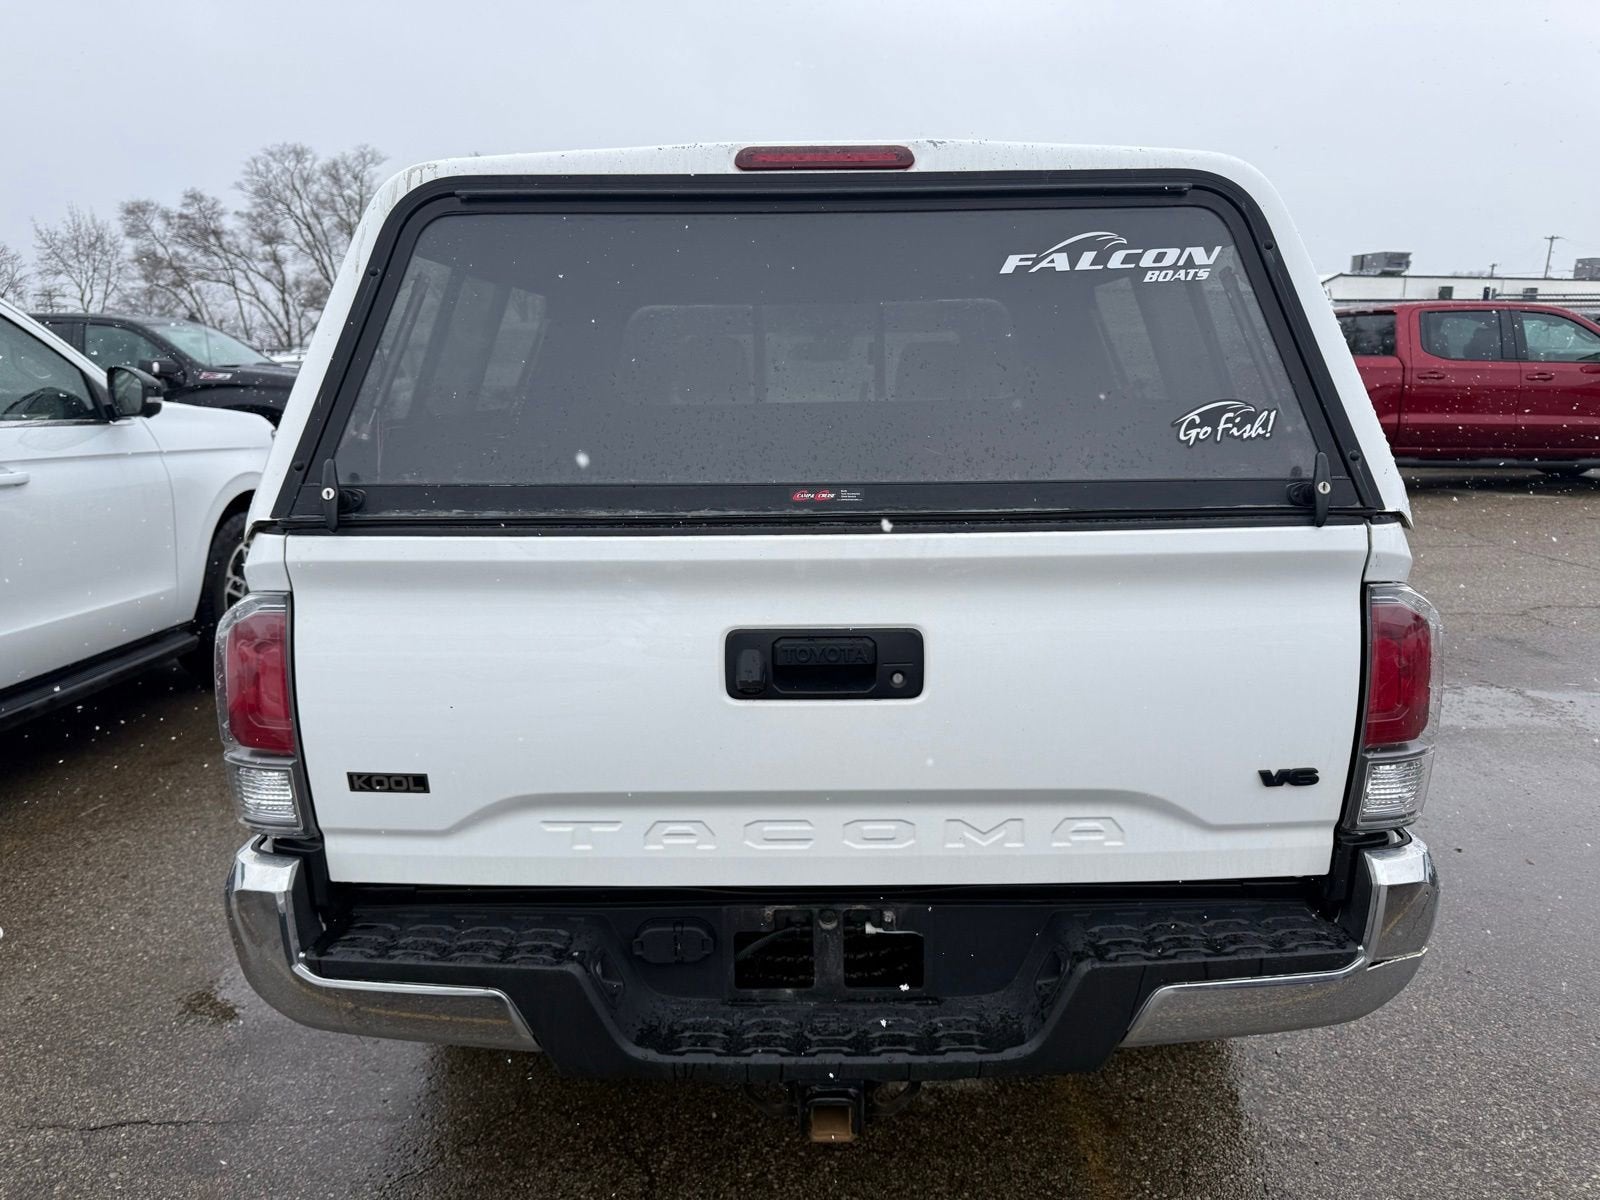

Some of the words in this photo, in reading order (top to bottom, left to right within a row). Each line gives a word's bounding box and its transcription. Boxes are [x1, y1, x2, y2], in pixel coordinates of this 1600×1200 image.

[999, 246, 1222, 274] FALCON
[1143, 268, 1211, 283] BOATS
[1179, 414, 1212, 446] Go
[1217, 410, 1277, 442] Fish!
[783, 646, 868, 664] TOYOTA
[352, 774, 426, 792] KOOL
[1258, 767, 1320, 787] V6
[540, 817, 1125, 850] TACOMA
